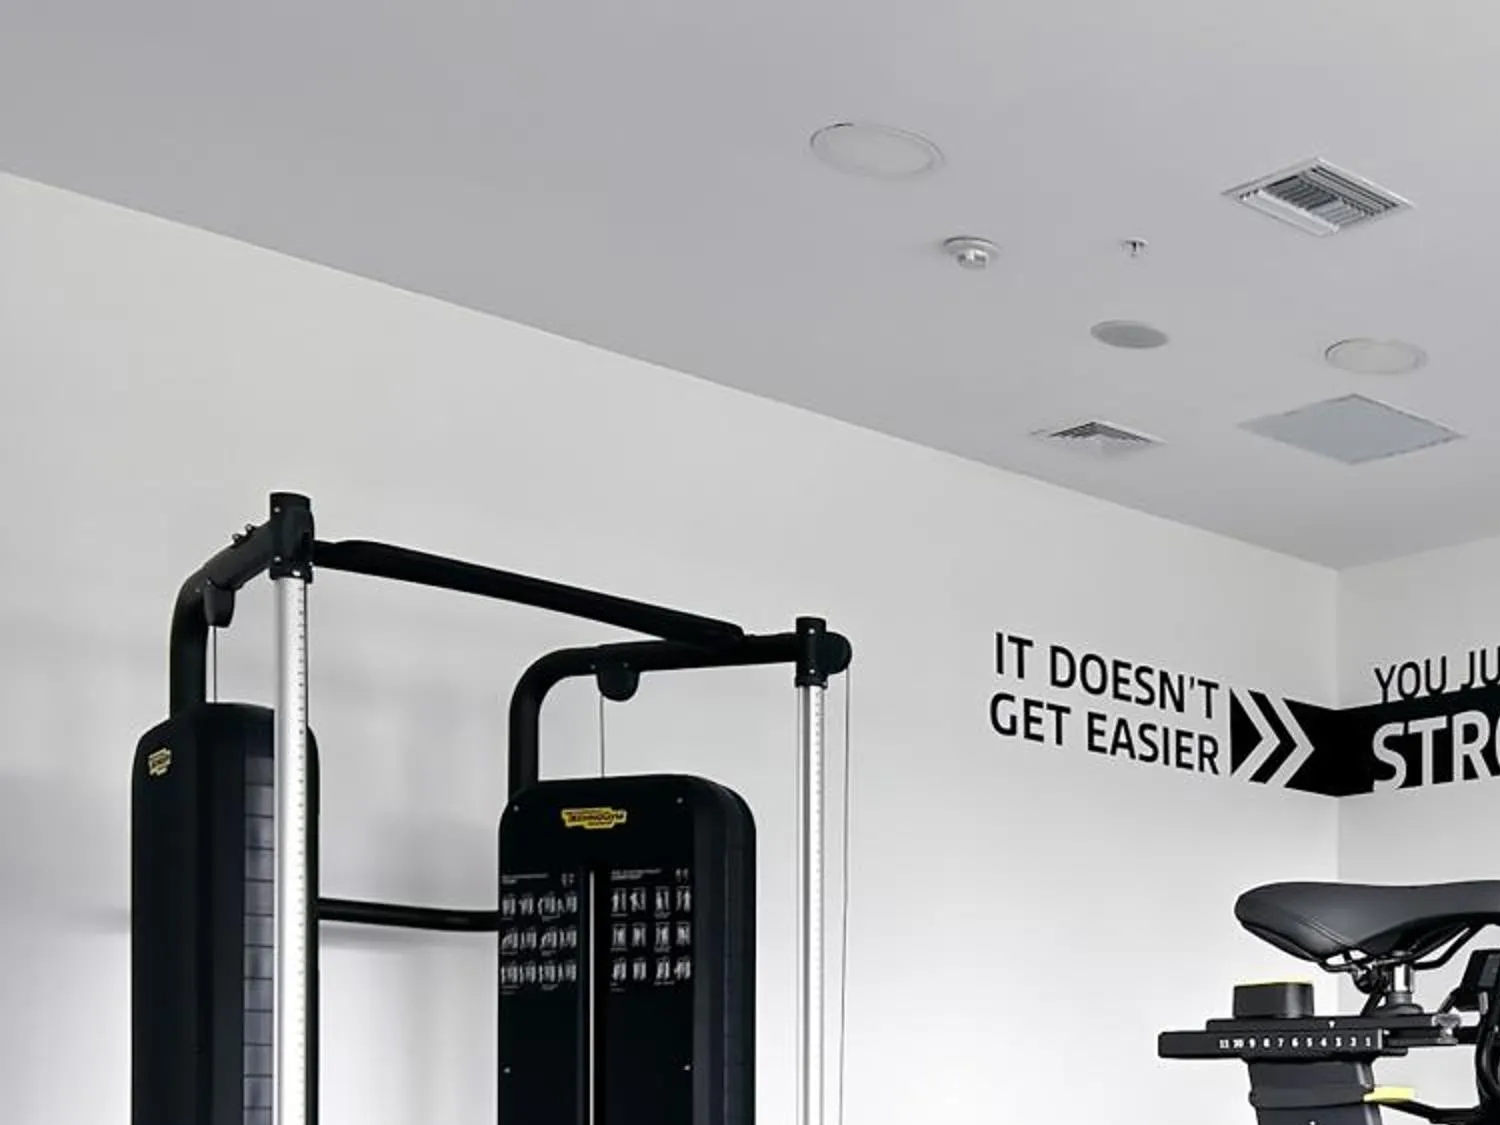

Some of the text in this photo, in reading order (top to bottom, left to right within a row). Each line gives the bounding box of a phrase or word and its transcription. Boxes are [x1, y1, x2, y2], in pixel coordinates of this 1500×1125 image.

[996, 632, 1219, 719] IT DOESN'T
[1374, 655, 1448, 702] YOU
[990, 692, 1219, 775] GET EASIER
[1277, 1037, 1285, 1048] 7
[1320, 1037, 1328, 1048] 4
